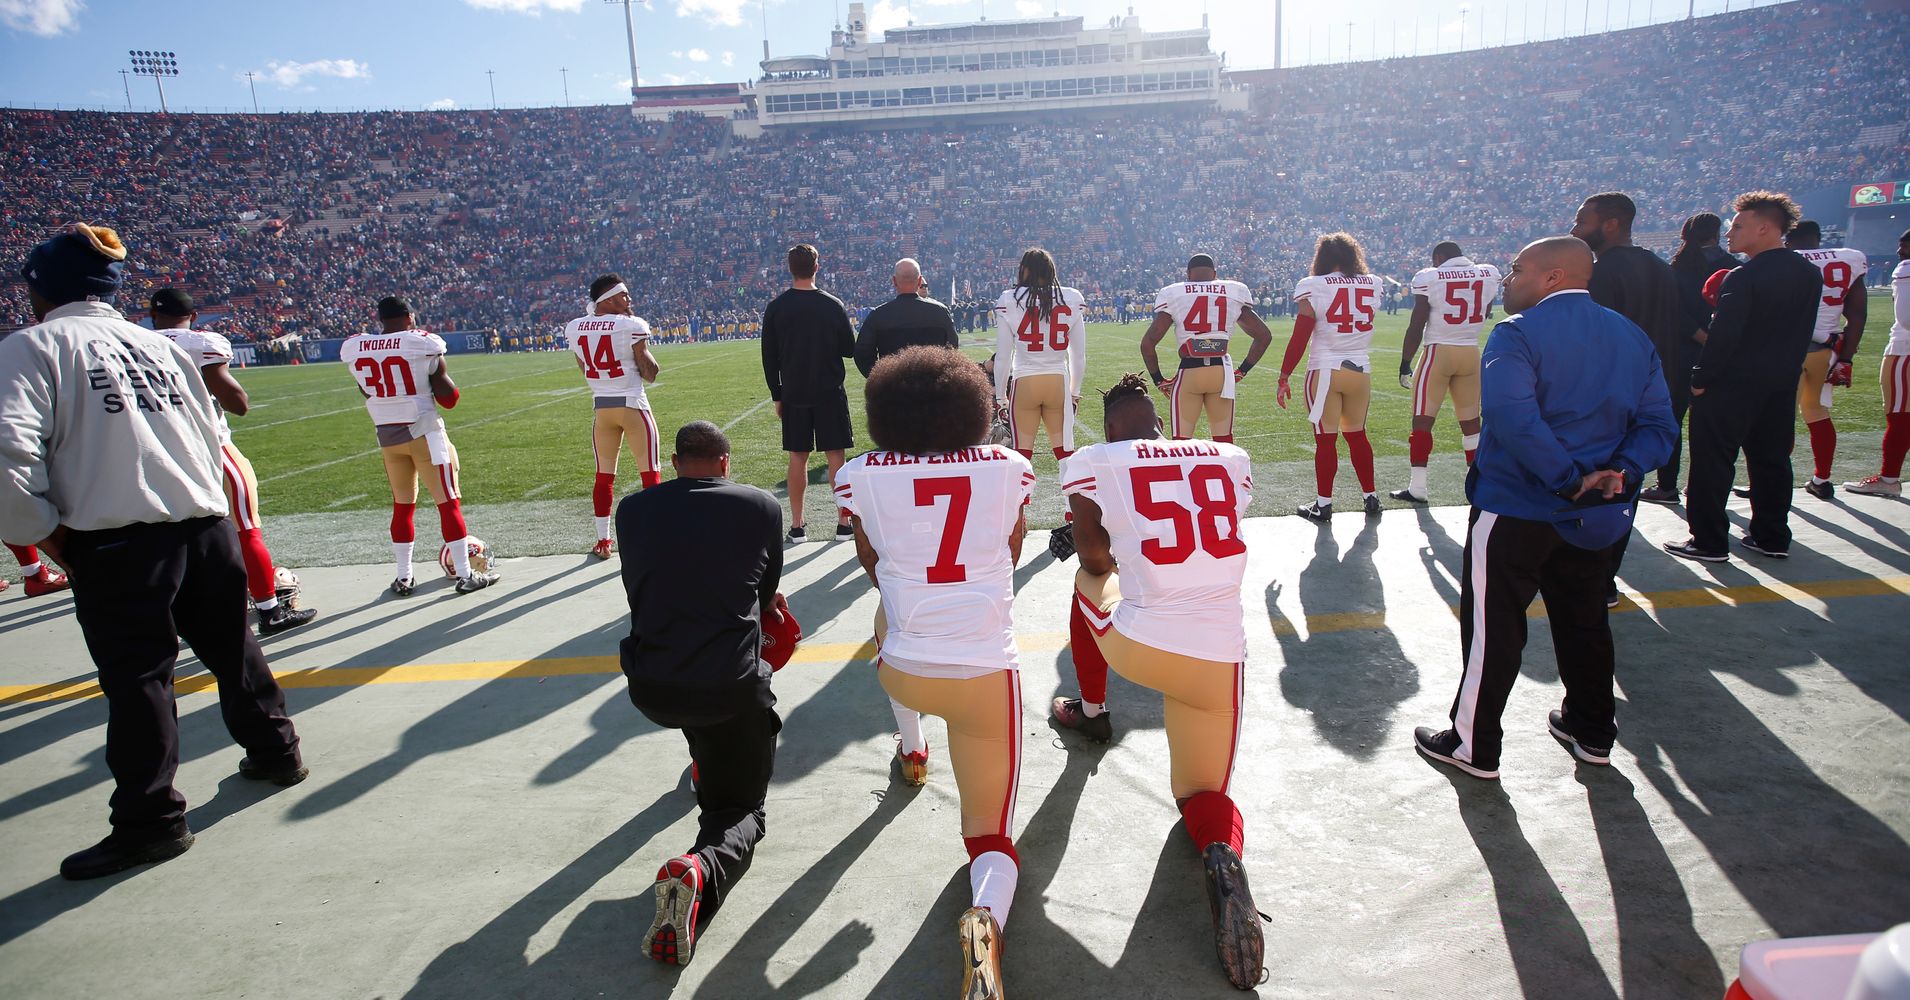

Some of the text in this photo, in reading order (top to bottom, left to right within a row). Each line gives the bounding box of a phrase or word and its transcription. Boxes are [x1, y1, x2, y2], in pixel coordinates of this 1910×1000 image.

[1802, 251, 1837, 261] ARTT
[1184, 283, 1227, 294] BETHEA
[1324, 276, 1374, 285] BRADFORD
[1437, 269, 1491, 280] HODGES JR
[1183, 295, 1228, 335] 41
[1325, 287, 1375, 333] 45
[1443, 280, 1483, 325] 51
[577, 321, 616, 331] HARPER
[1016, 304, 1072, 352] 46
[359, 337, 401, 352] IWORAH
[577, 334, 625, 379] 14
[354, 355, 417, 398] 30
[103, 393, 183, 414] STAFF
[1135, 442, 1220, 459] HAROLD
[913, 475, 972, 585] 7
[1128, 464, 1247, 566] 58
